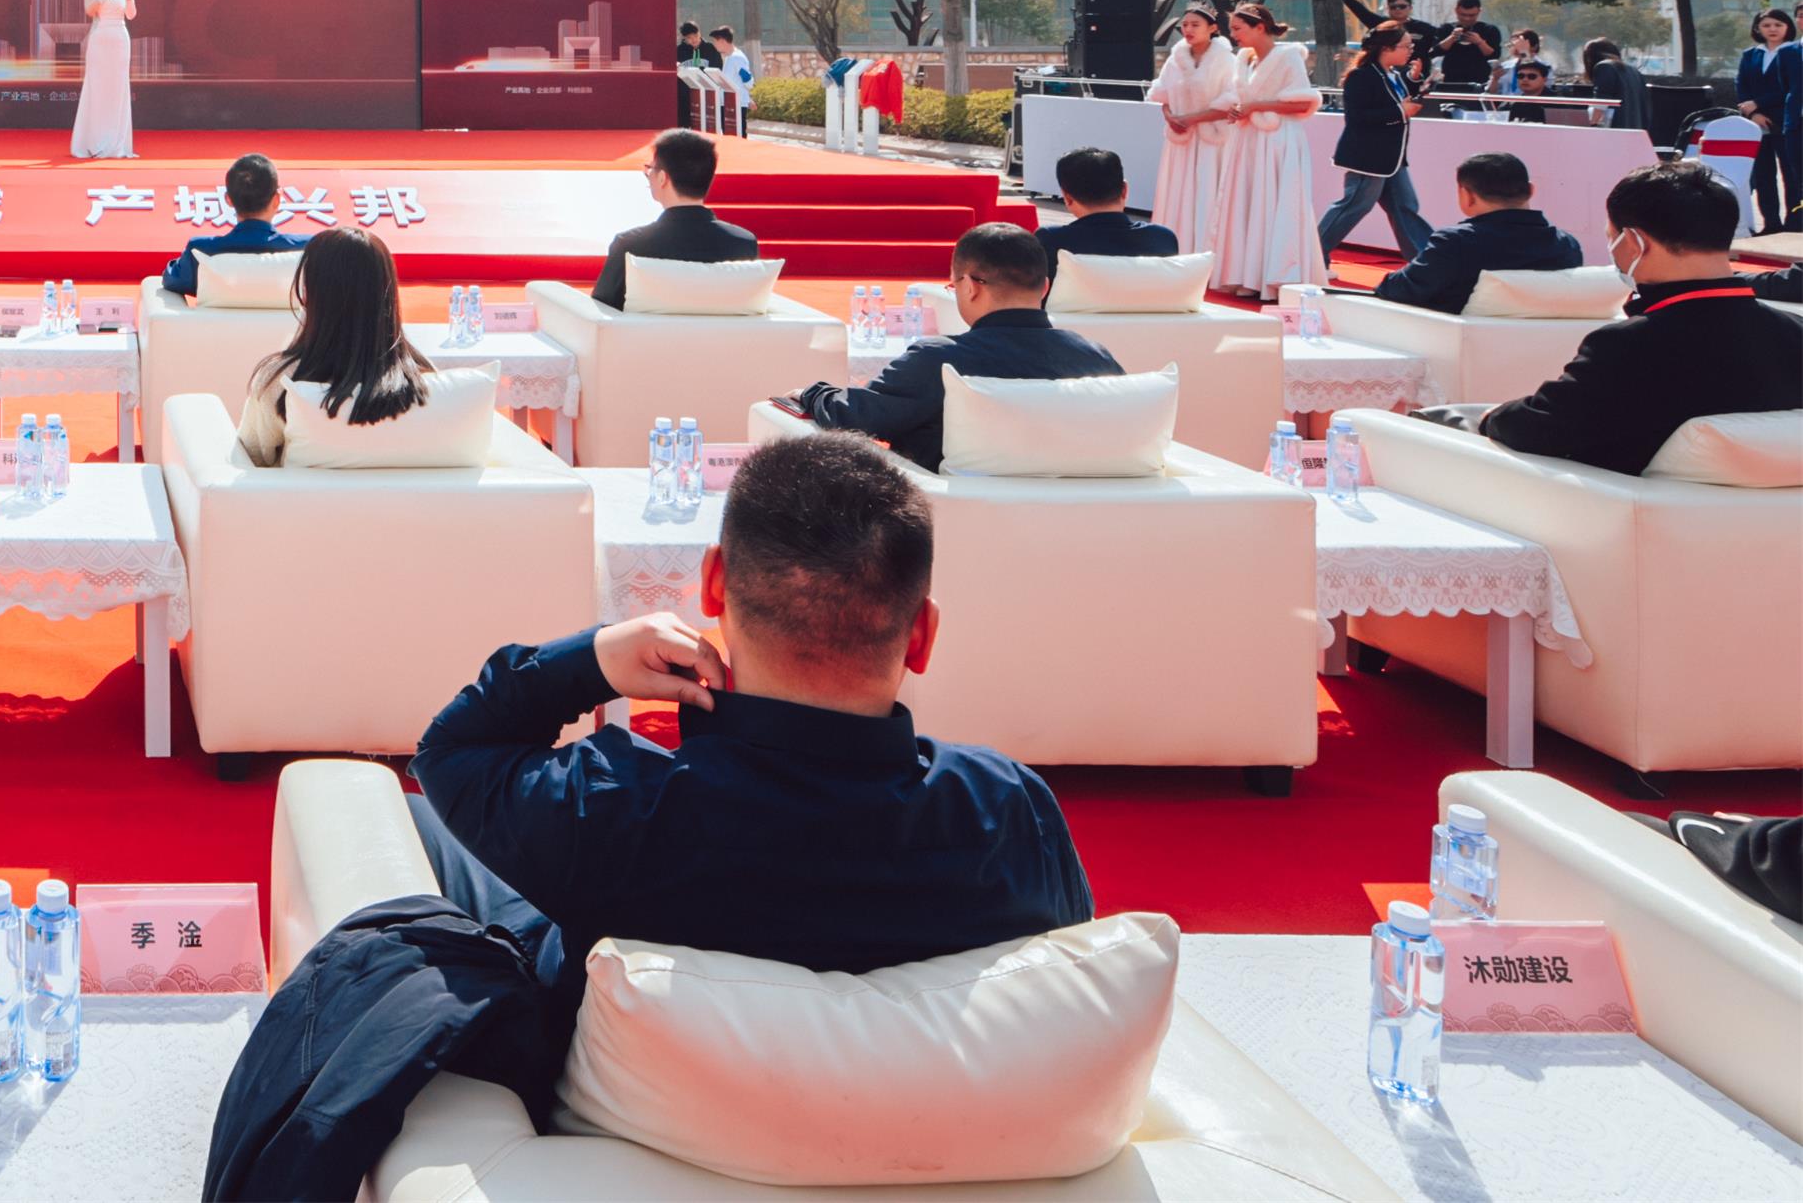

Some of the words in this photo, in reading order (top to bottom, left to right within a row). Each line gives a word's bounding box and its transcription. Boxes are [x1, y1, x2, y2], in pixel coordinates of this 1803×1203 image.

[85, 185, 428, 227] 产城兴邦
[130, 921, 203, 949] 季淦
[1462, 955, 1573, 984] 沐勋建设
